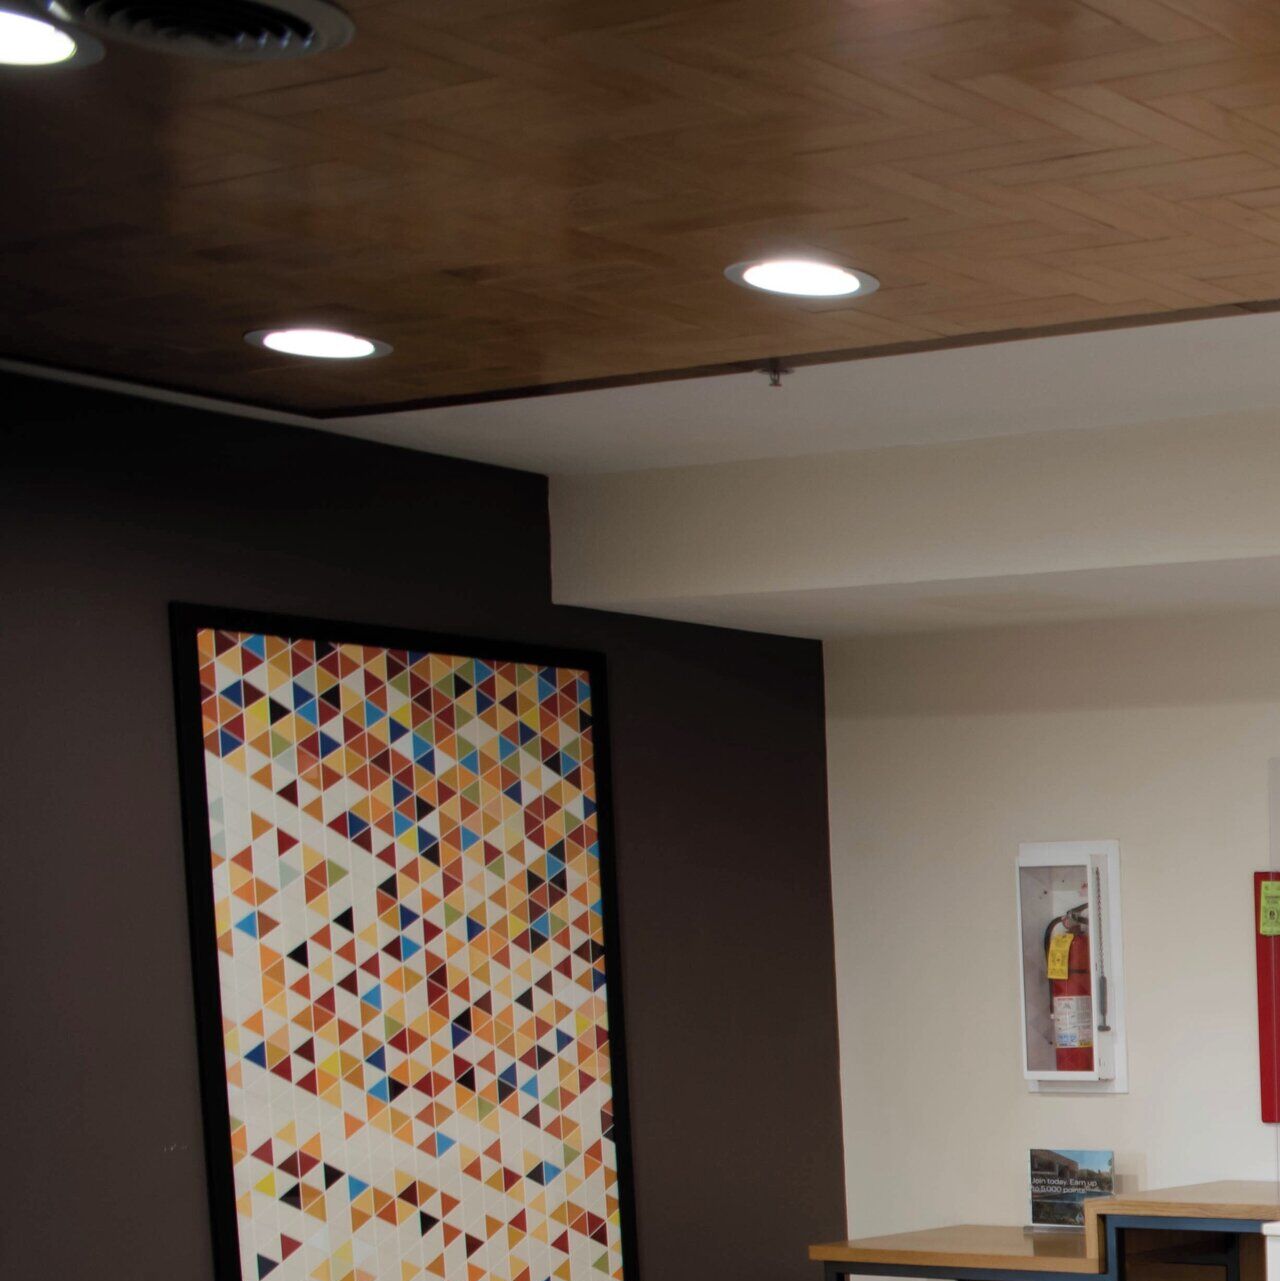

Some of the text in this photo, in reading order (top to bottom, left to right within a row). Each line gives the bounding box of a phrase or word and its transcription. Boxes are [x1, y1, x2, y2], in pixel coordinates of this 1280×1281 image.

[1032, 1177, 1098, 1188] Join today. Earn up
